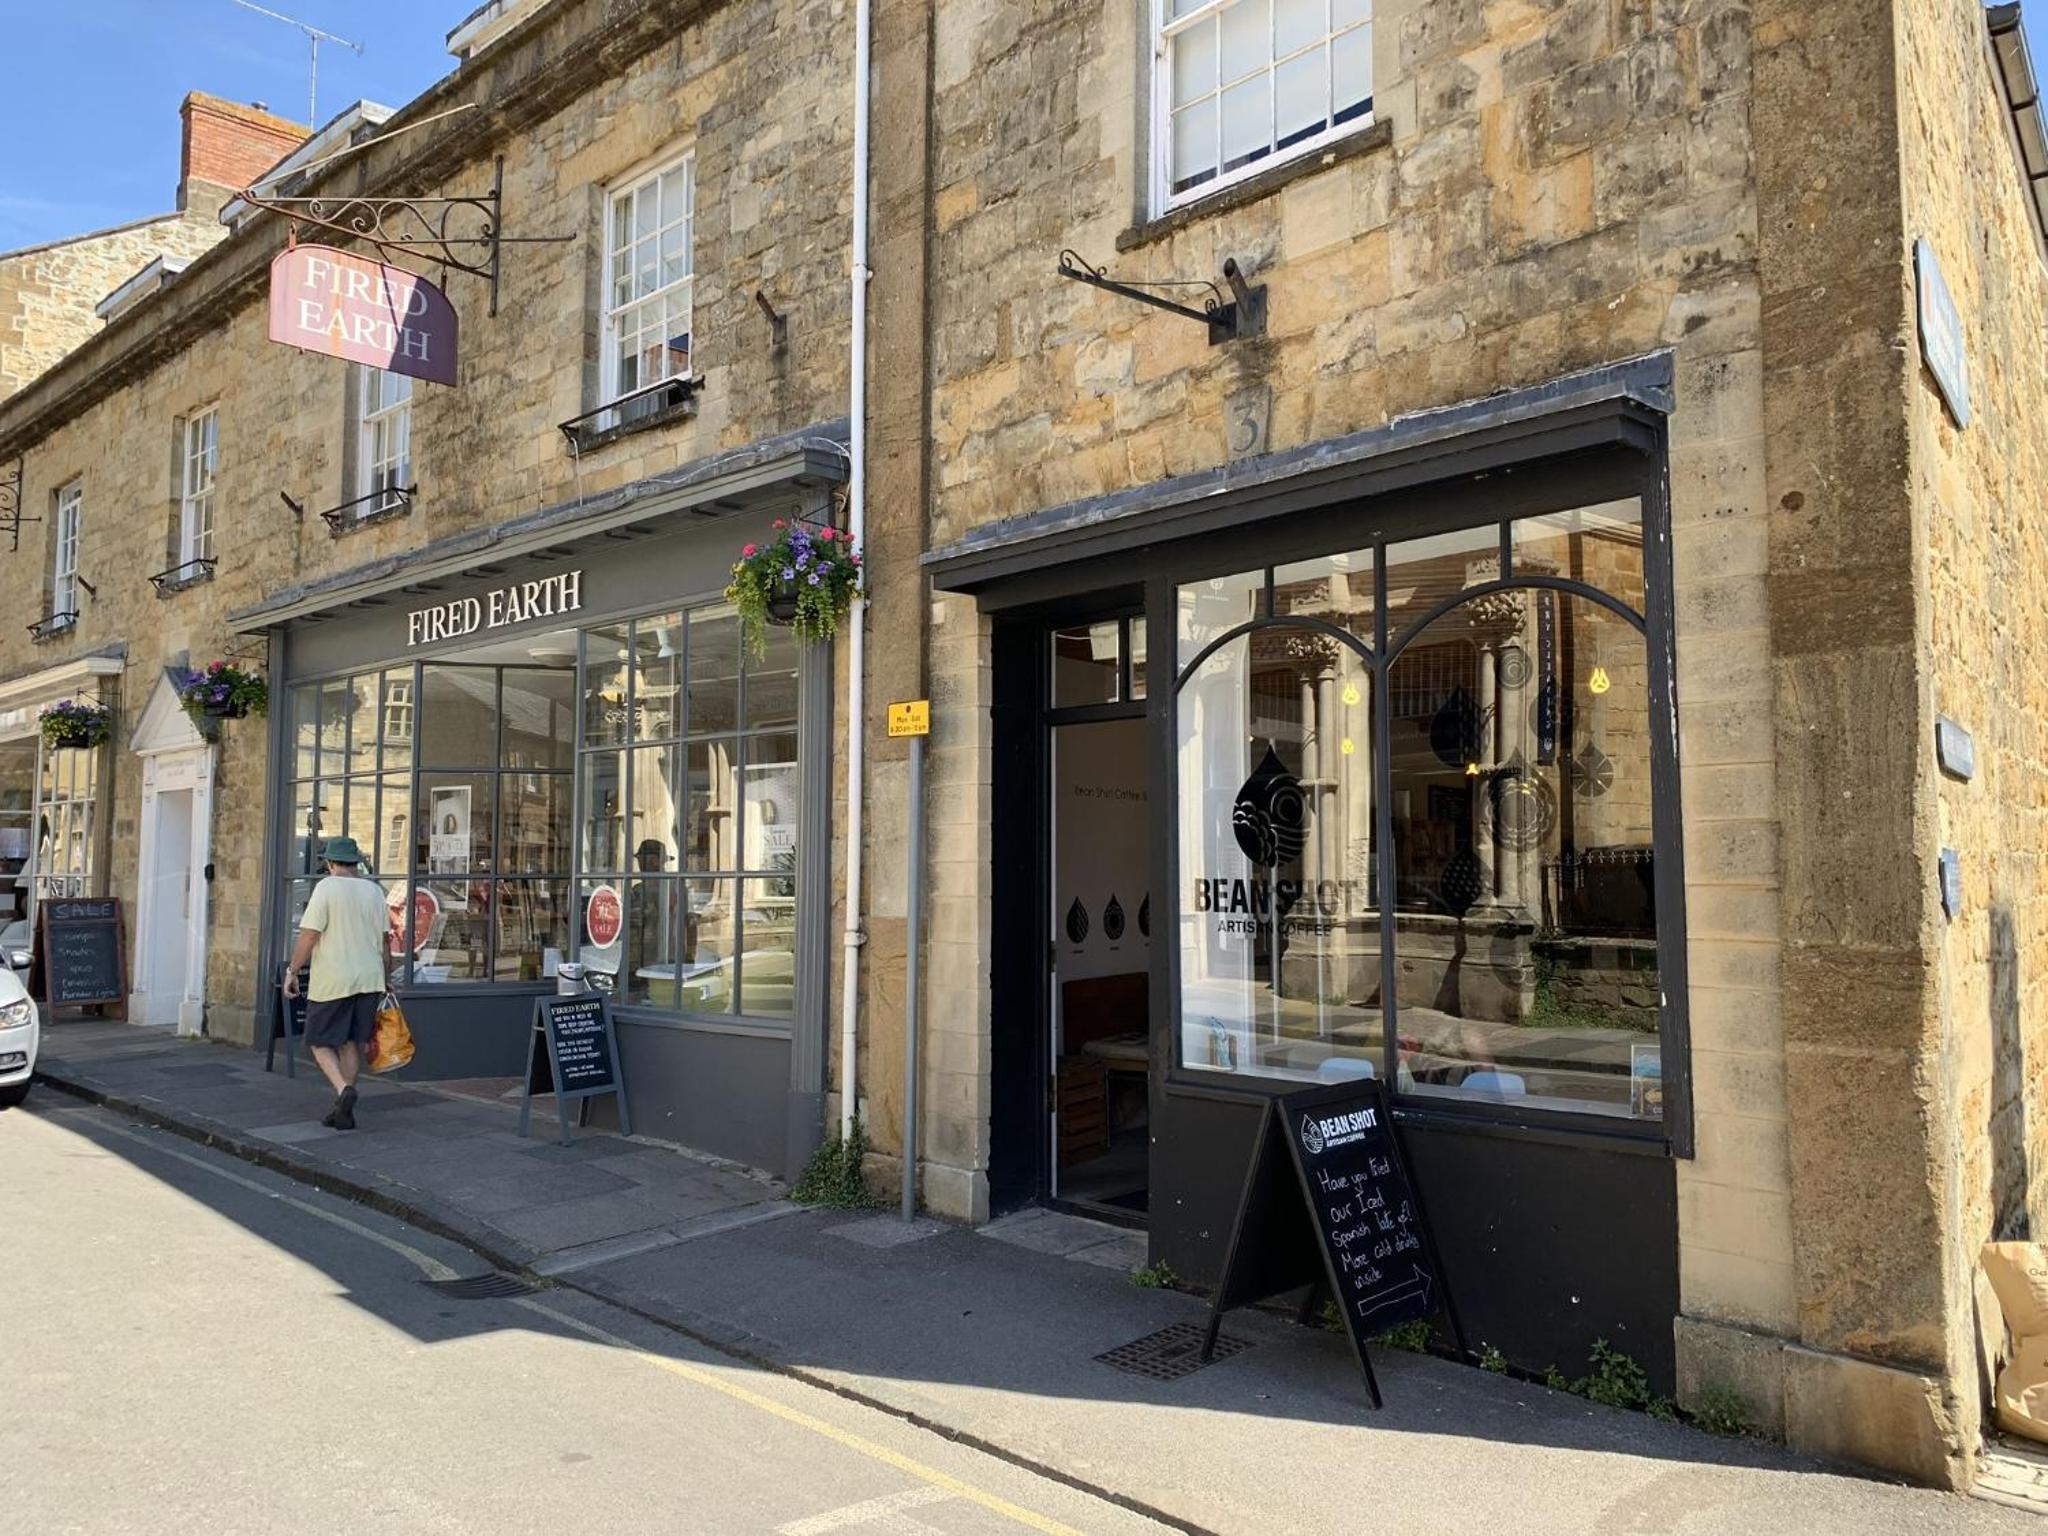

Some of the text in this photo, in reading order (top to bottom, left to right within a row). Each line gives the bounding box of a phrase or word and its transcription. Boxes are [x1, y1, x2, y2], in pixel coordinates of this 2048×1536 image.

[303, 256, 428, 317] FIRED
[297, 299, 432, 362] EARTH
[407, 570, 582, 646] FIRED EARTH
[55, 903, 113, 919] SALE
[1194, 878, 1358, 918] BEAN SHOT
[1218, 920, 1332, 937] ARTISAN COFFEE
[551, 1002, 600, 1015] FIRED EARTH
[1319, 1108, 1377, 1138] BEAN SHOT
[1317, 1156, 1391, 1197] Have you tried
[1355, 1186, 1386, 1214] Iced
[1331, 1221, 1372, 1250] Spanish
[1341, 1251, 1370, 1272] More
[1354, 1266, 1383, 1290] inside
